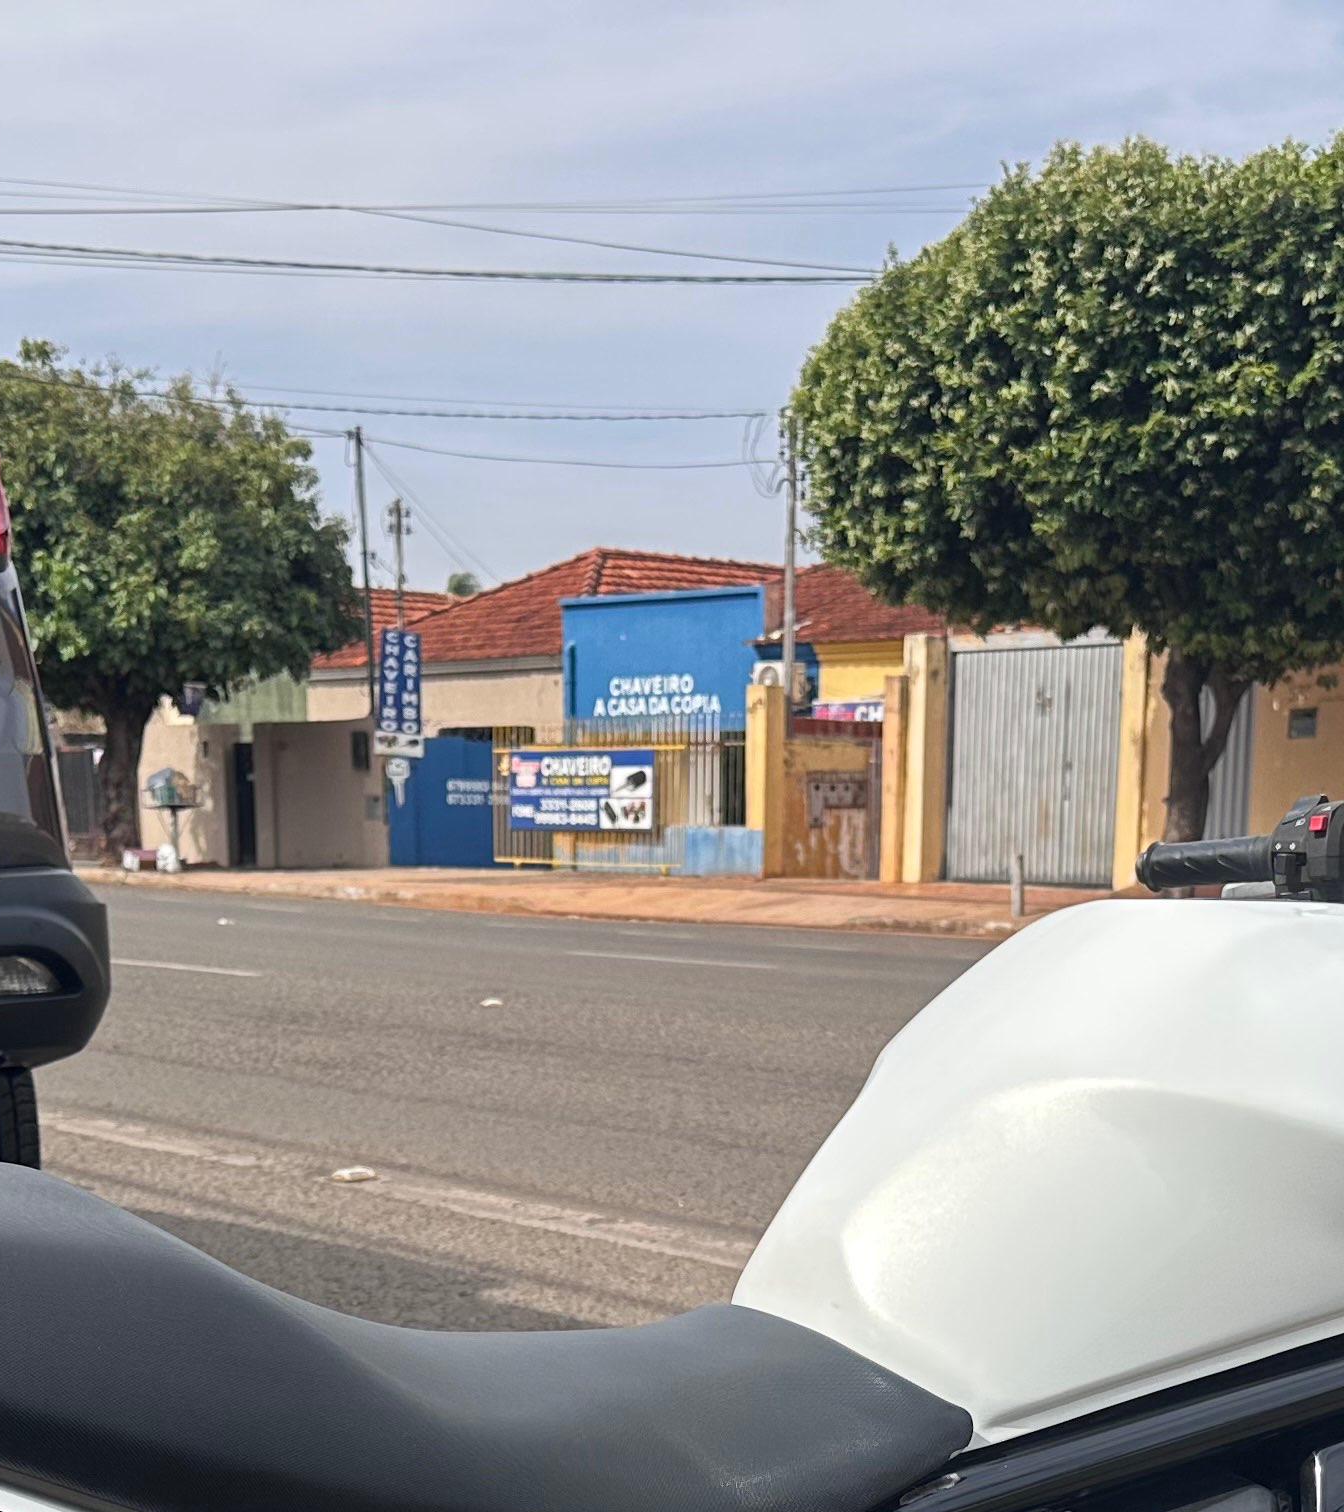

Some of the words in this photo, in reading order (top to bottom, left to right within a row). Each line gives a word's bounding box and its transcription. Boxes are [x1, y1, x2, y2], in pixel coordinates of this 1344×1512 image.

[380, 632, 400, 732] CHAVEIRO
[401, 635, 419, 734] CARIMBO
[593, 697, 607, 717] A
[607, 695, 648, 717] CASA
[648, 695, 671, 715] DA
[609, 673, 695, 696] CHAVEIRO
